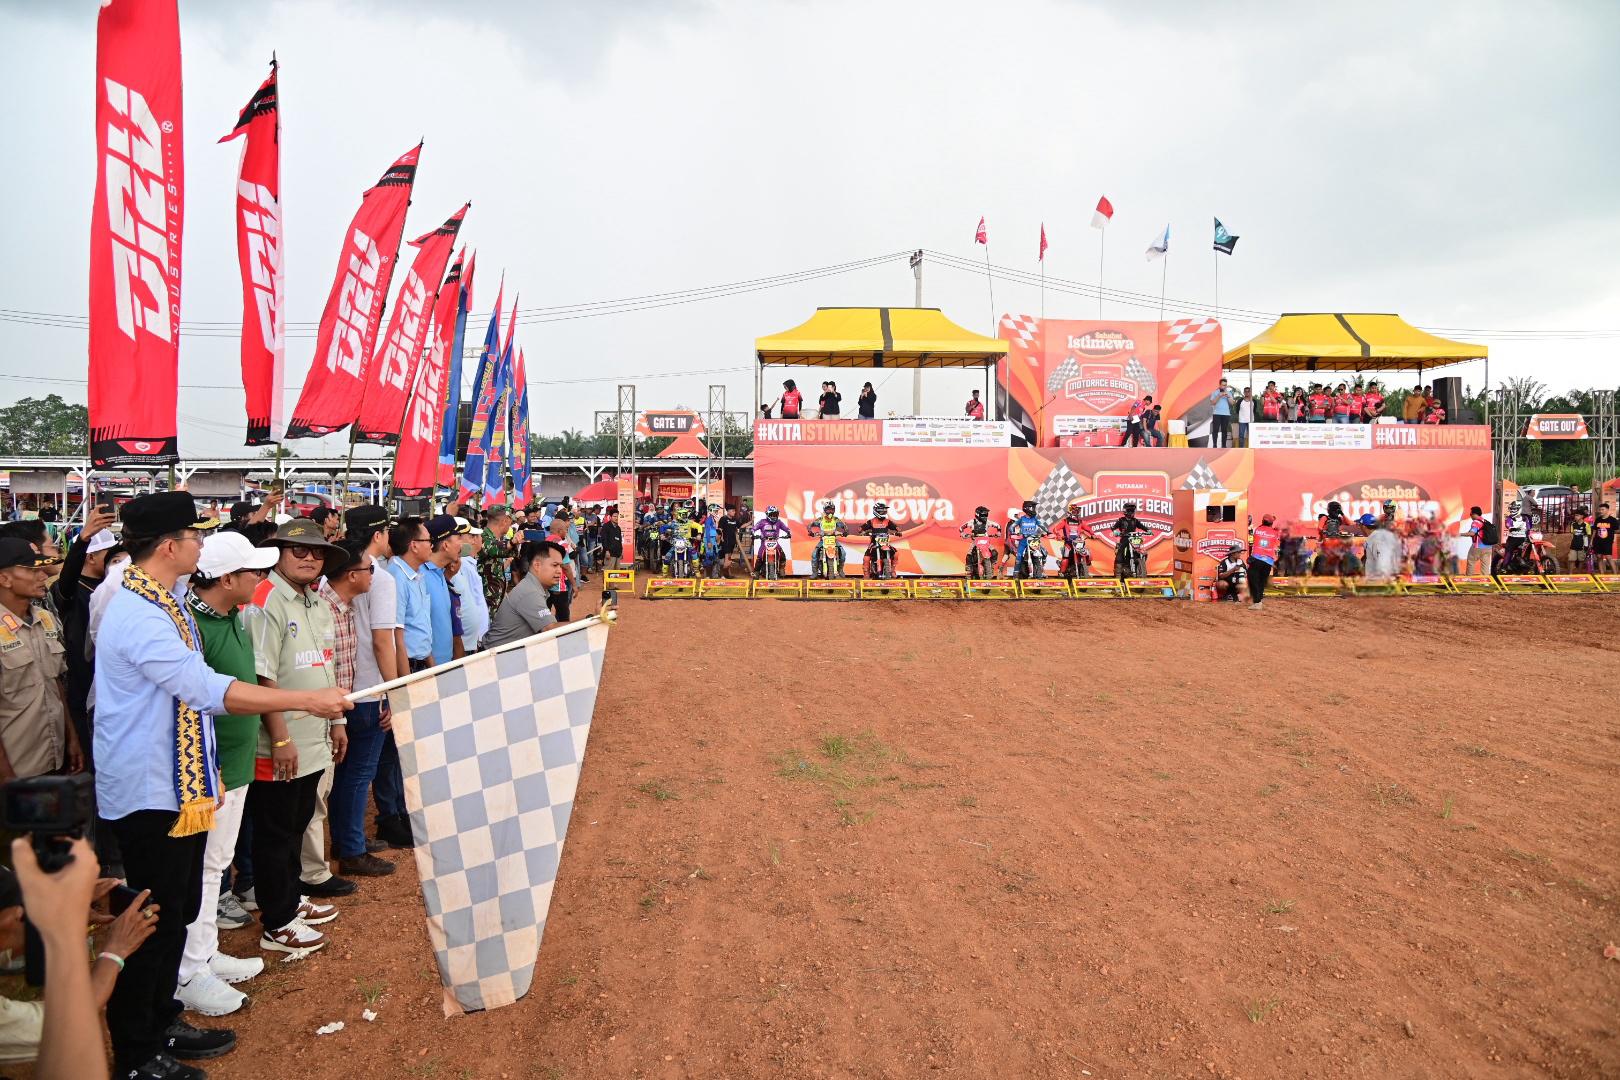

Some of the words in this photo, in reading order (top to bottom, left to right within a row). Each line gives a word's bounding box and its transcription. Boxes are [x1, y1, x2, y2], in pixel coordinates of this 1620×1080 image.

[166, 180, 181, 348] NDUSTRIES
[1067, 334, 1135, 350] Istimewa
[1069, 377, 1109, 390] MOTORACE
[653, 417, 675, 429] GATE
[677, 417, 687, 429] IN
[1539, 421, 1559, 432] GATE
[1560, 421, 1576, 432] OUT
[865, 482, 928, 498] Sahabat
[1361, 485, 1419, 499] Sahabat
[802, 489, 955, 521] Istimewa
[1145, 498, 1174, 516] SERI
